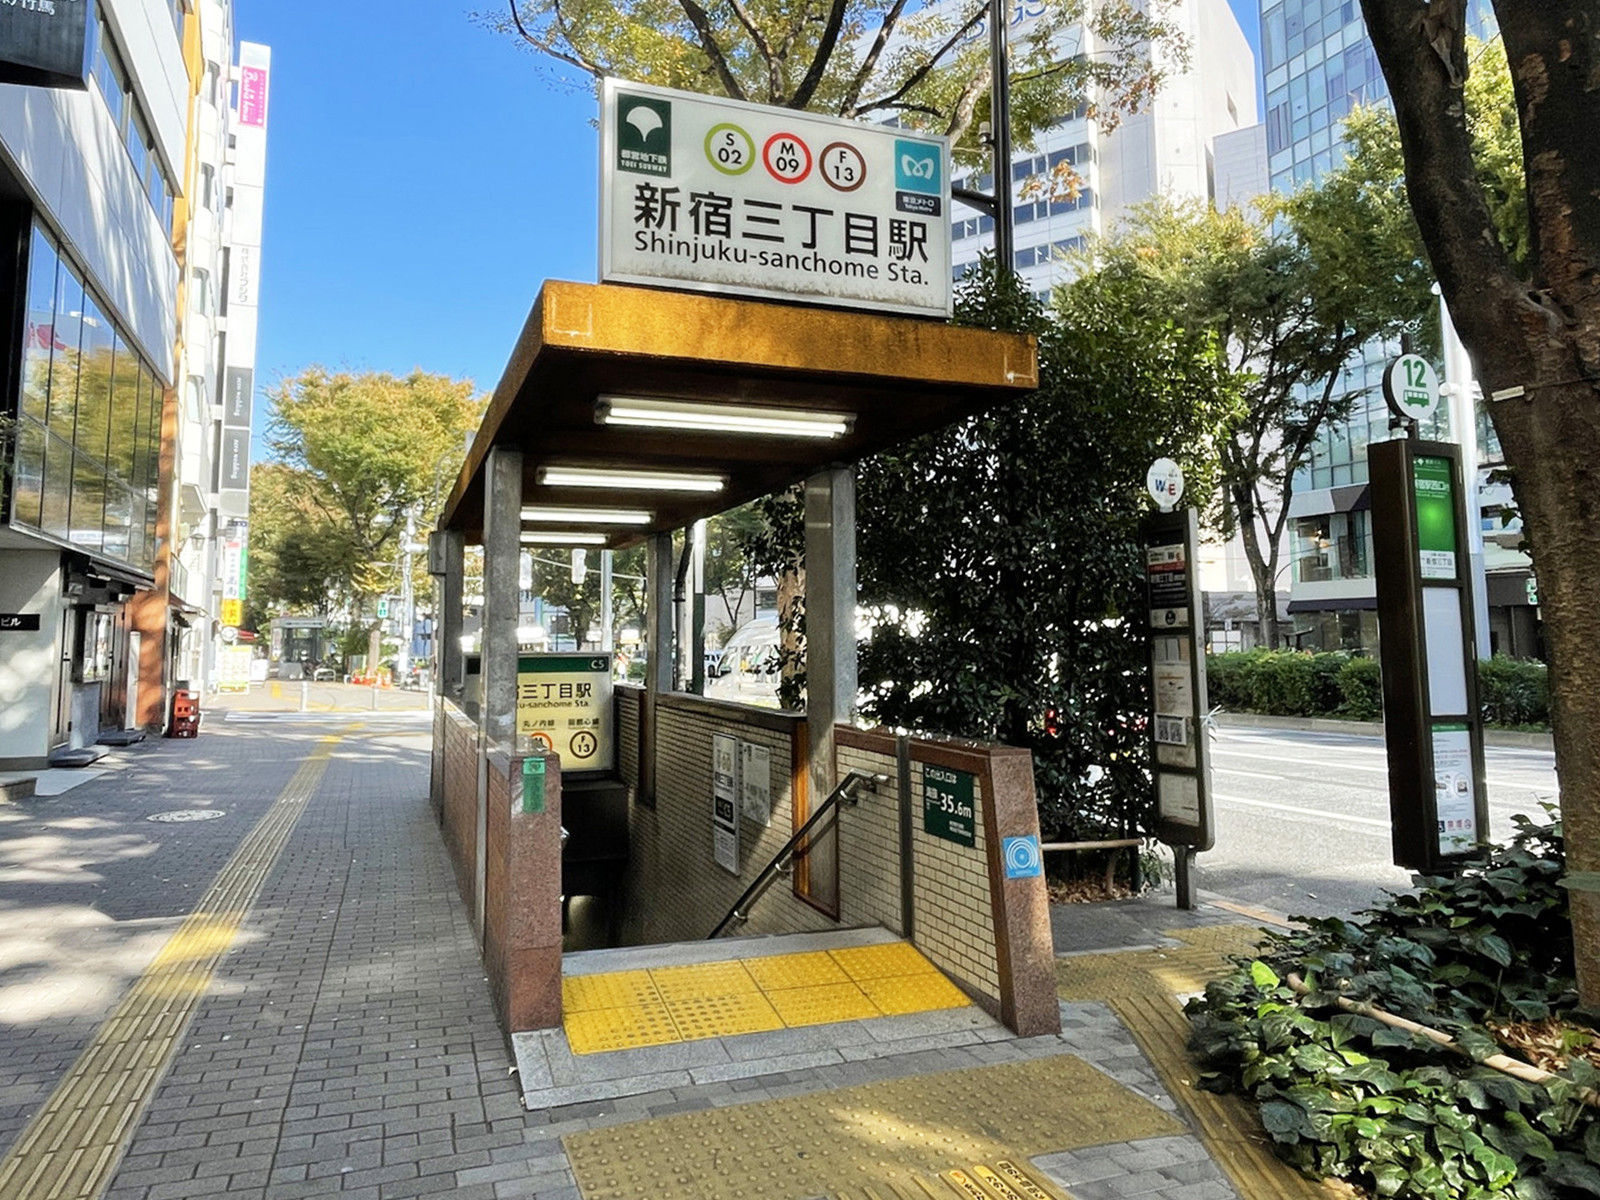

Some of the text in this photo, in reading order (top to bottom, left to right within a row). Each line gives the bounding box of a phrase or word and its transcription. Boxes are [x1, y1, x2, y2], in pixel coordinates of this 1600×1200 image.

[726, 132, 735, 147] S
[718, 148, 742, 165] 02
[780, 142, 796, 156] M
[776, 156, 800, 174] 09
[839, 151, 847, 164] F
[833, 165, 855, 183] 13
[634, 181, 929, 263] 新宿三丁目駅
[634, 230, 929, 286] Shinjuku-sanchome Sta.
[1402, 358, 1427, 389] 12
[1, 617, 21, 626] ビル
[591, 660, 605, 669] C5
[517, 683, 592, 699] 三丁目駅
[517, 701, 572, 709] u-sanchome
[581, 735, 586, 743] F
[577, 744, 590, 753] 13
[940, 793, 972, 818] 35.6m
